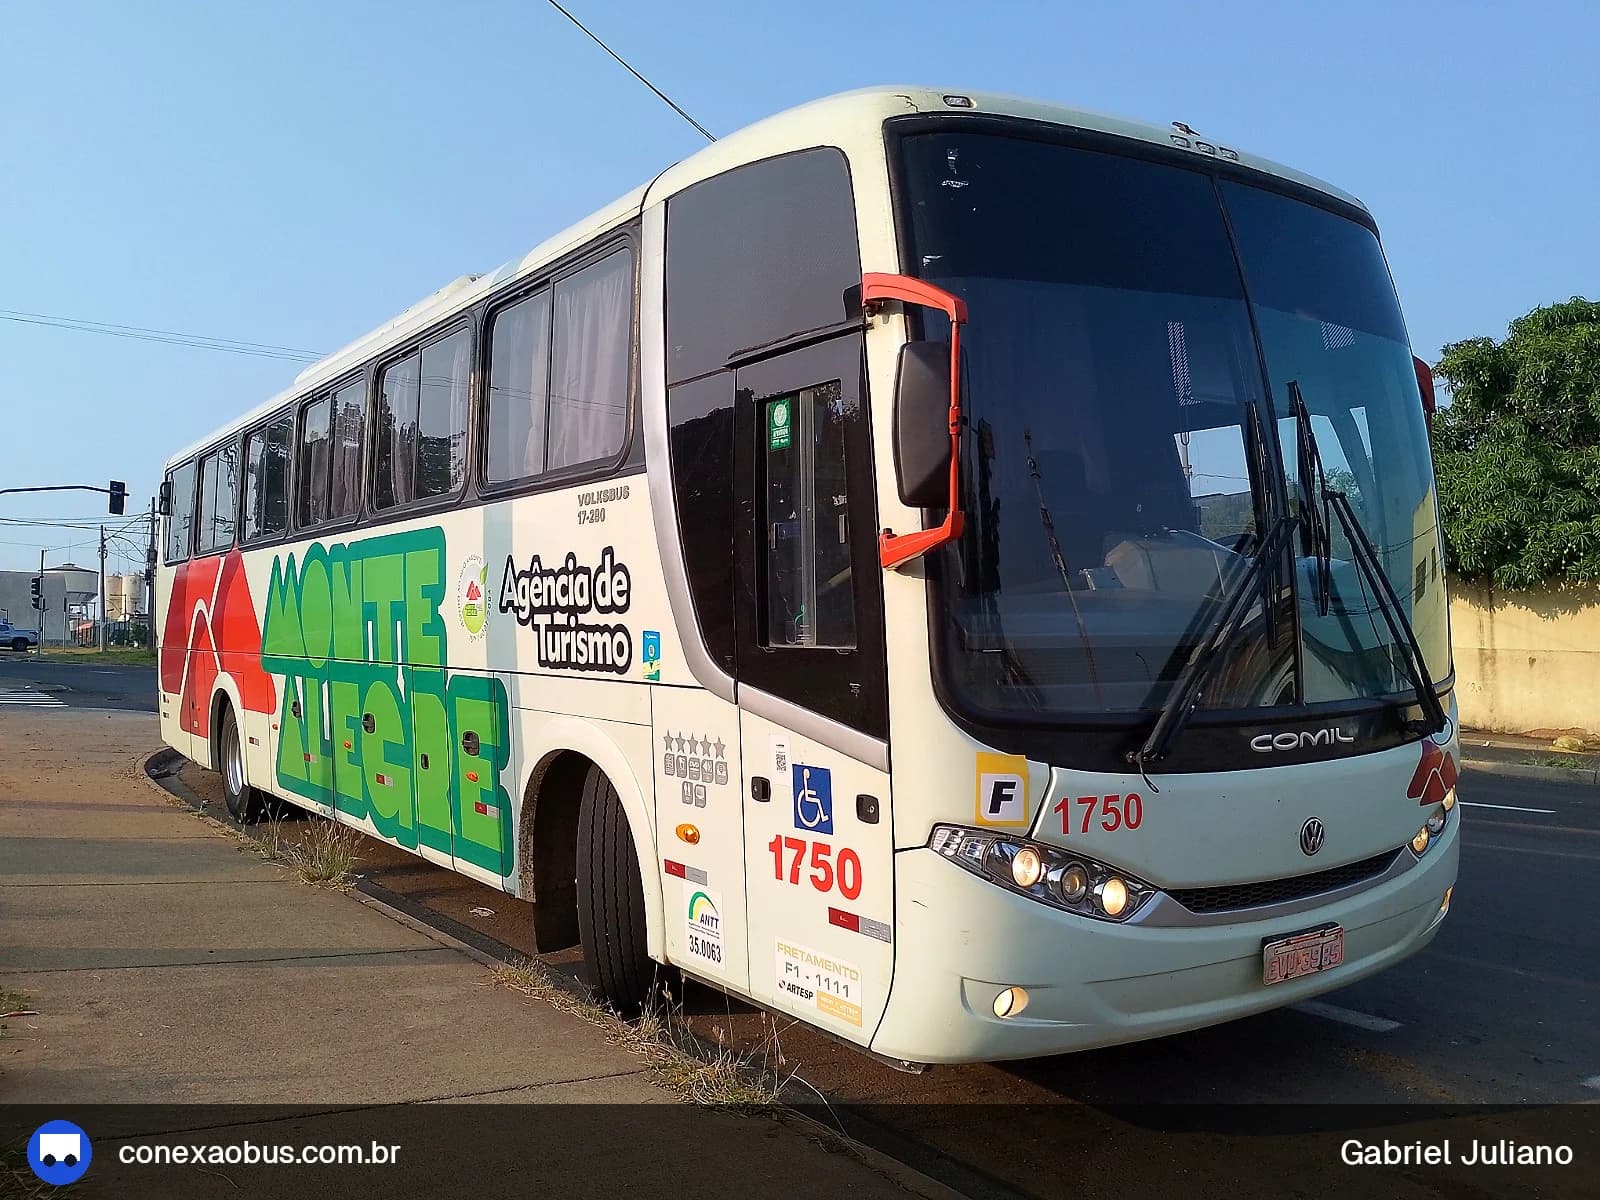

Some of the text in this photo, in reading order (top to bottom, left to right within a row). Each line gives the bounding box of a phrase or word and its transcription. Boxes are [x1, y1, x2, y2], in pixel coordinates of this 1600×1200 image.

[578, 485, 630, 507] VOLKSBUS
[578, 507, 606, 525] 17-280
[500, 552, 592, 625] Agência
[593, 547, 631, 614] de
[262, 546, 443, 673] MONTE
[533, 614, 632, 674] Turismo
[1250, 727, 1354, 752] COMIL
[280, 673, 504, 853] ALEGRE
[988, 780, 1017, 814] F
[1054, 793, 1143, 835] 1750
[769, 834, 862, 900] 1750
[700, 913, 719, 929] ANTT
[689, 935, 721, 963] 35.0063
[777, 942, 859, 981] FRETAMENTO
[787, 982, 814, 1000] ARTESP
